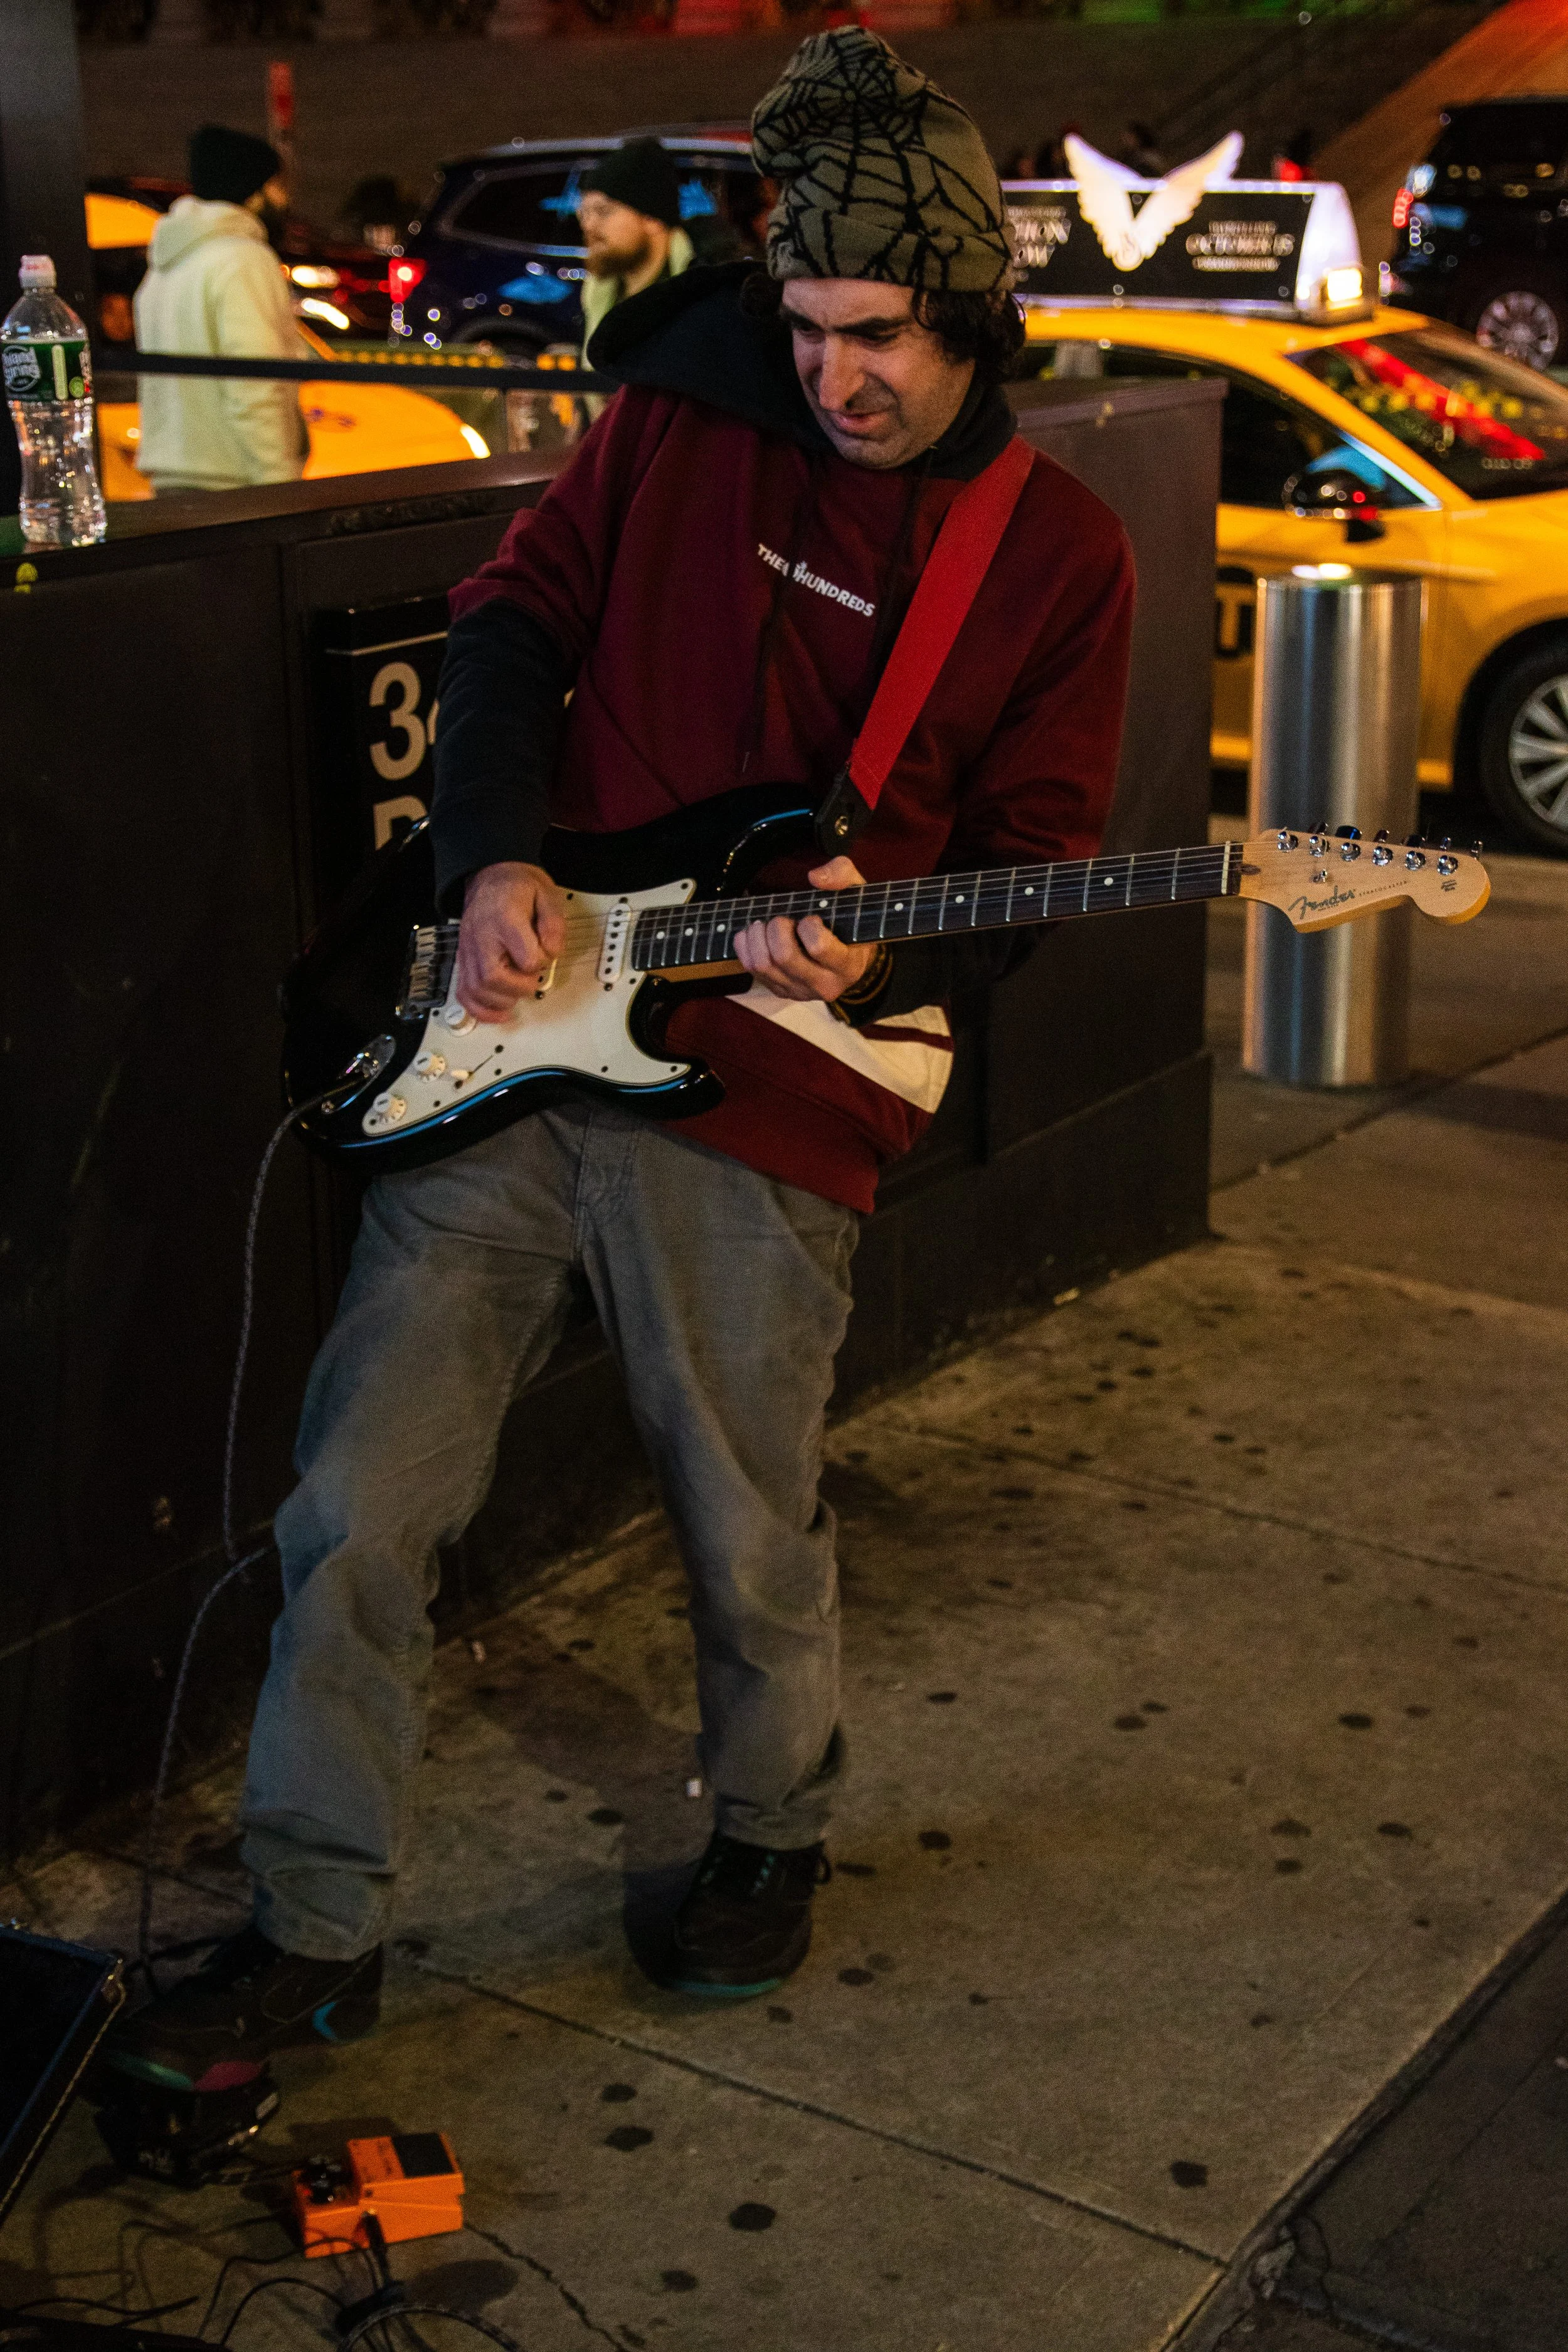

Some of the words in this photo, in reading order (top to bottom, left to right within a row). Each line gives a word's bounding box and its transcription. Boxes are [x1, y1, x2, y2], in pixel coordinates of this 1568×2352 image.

[758, 543, 786, 571] THE
[795, 565, 875, 617] HUNDREDS
[369, 661, 440, 780] 3
[1288, 885, 1355, 919] Fender
